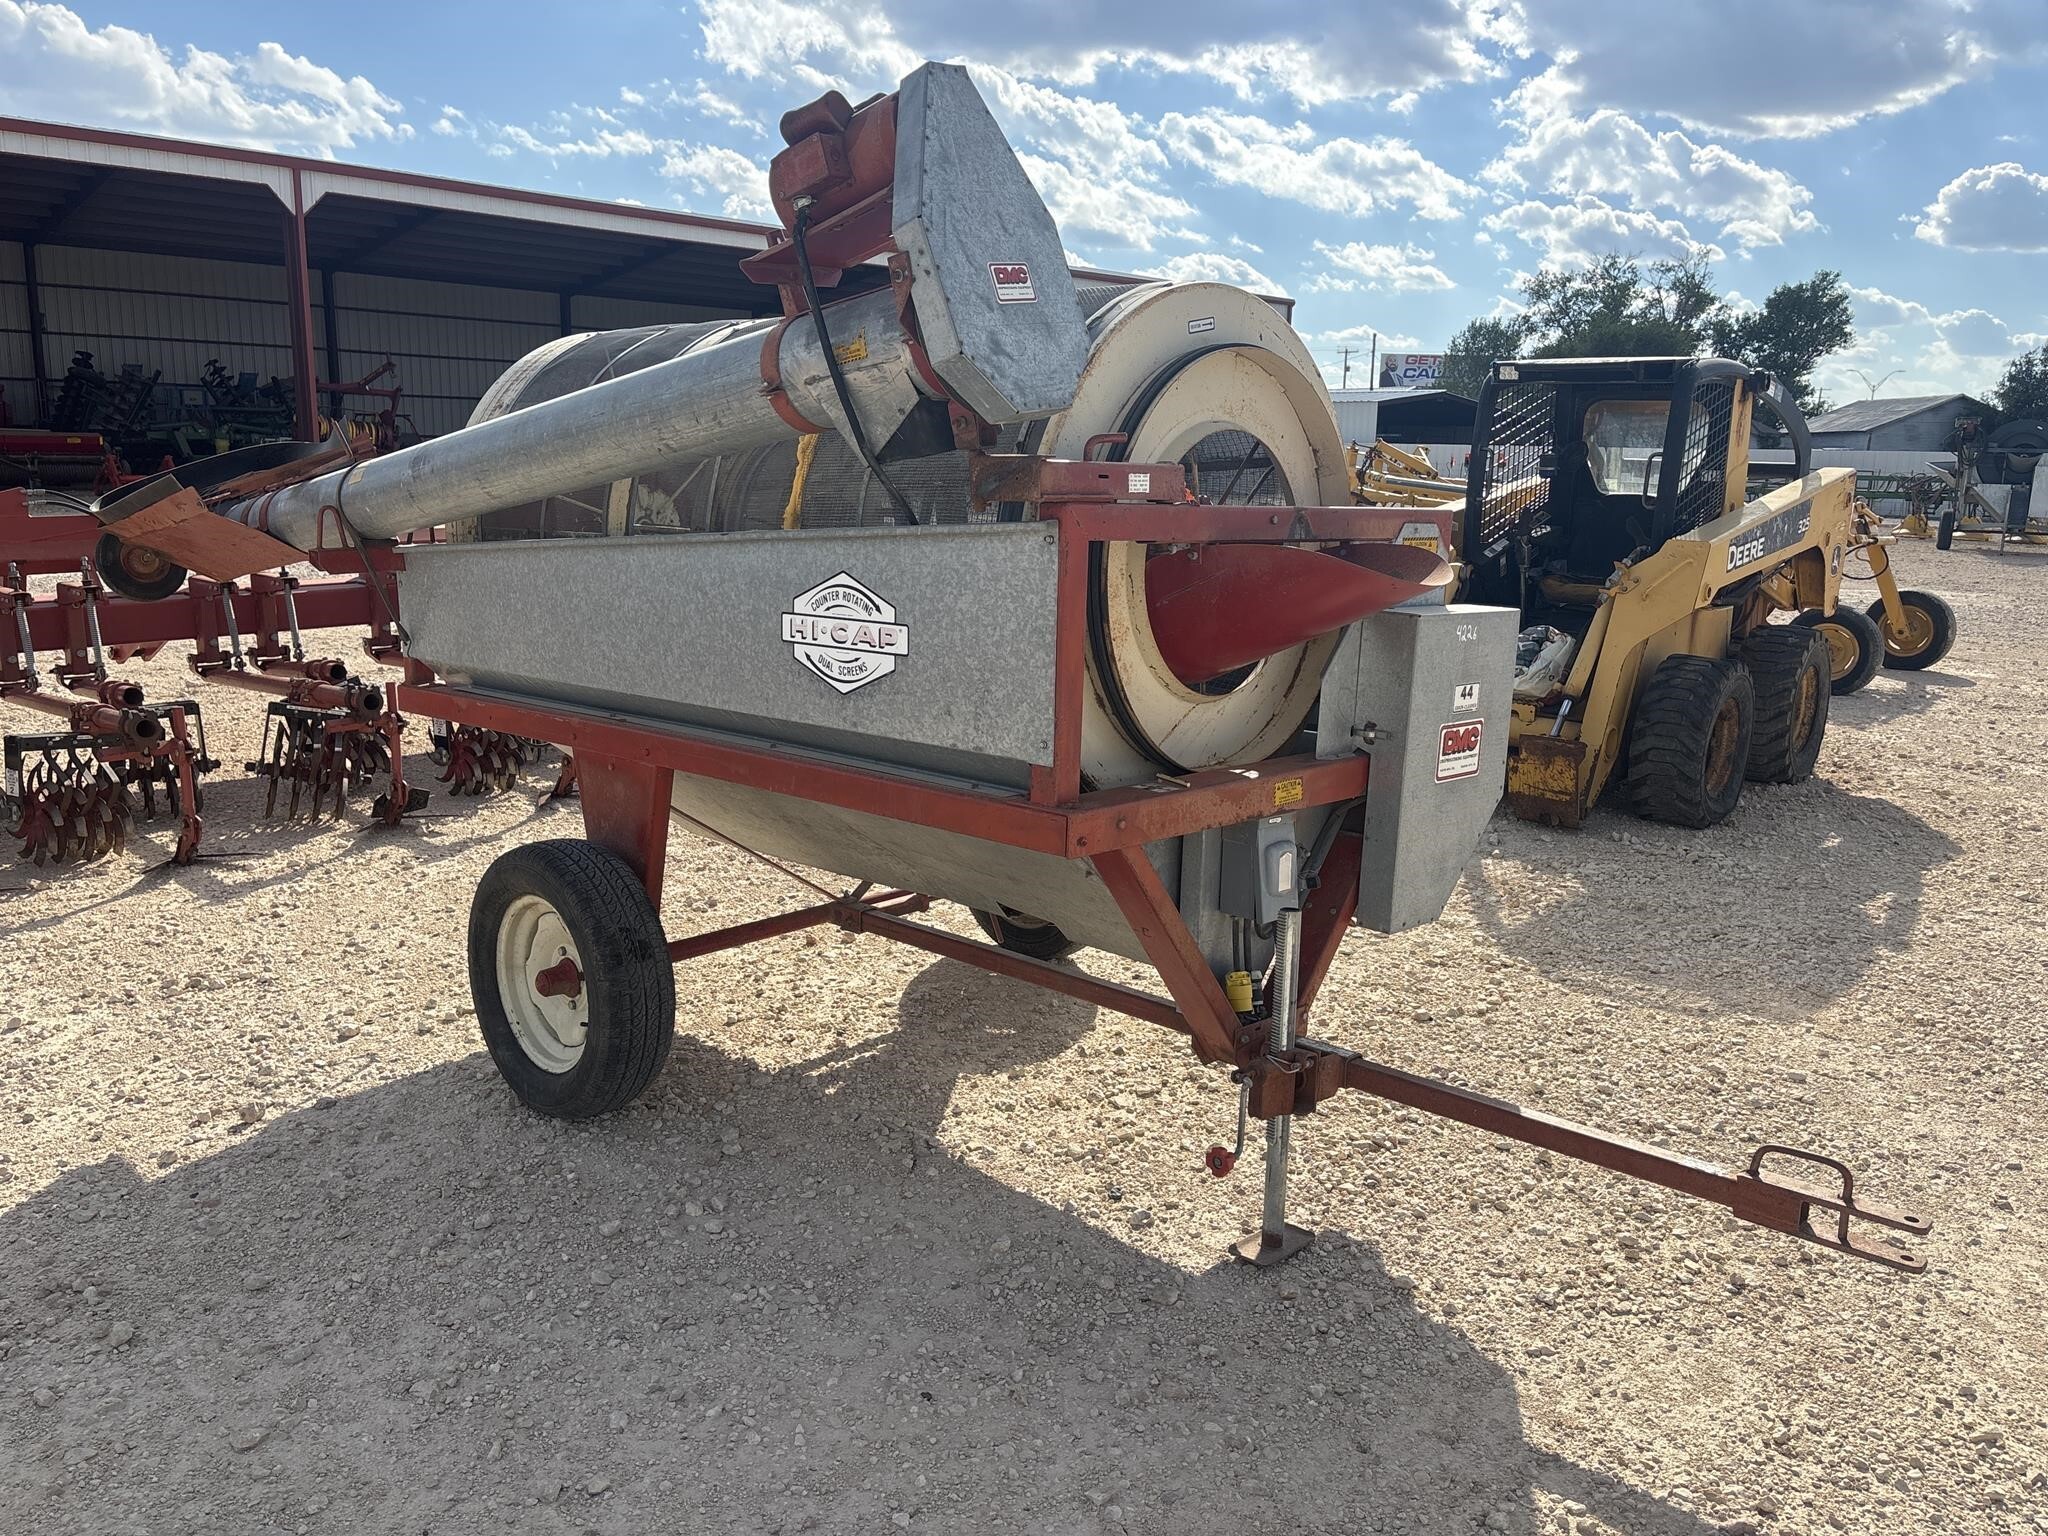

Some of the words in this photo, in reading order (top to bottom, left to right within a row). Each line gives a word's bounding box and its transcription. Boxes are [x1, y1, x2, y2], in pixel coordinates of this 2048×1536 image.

[1405, 355, 1443, 365] GET
[1727, 537, 1765, 571] DEERE
[811, 590, 840, 612] COUNTER
[842, 592, 874, 617] ROTATING
[1456, 624, 1478, 642] 4226
[818, 655, 834, 673] DUAL
[838, 661, 868, 677] SCREENS
[1460, 686, 1474, 700] 44
[1442, 726, 1480, 756] DMC
